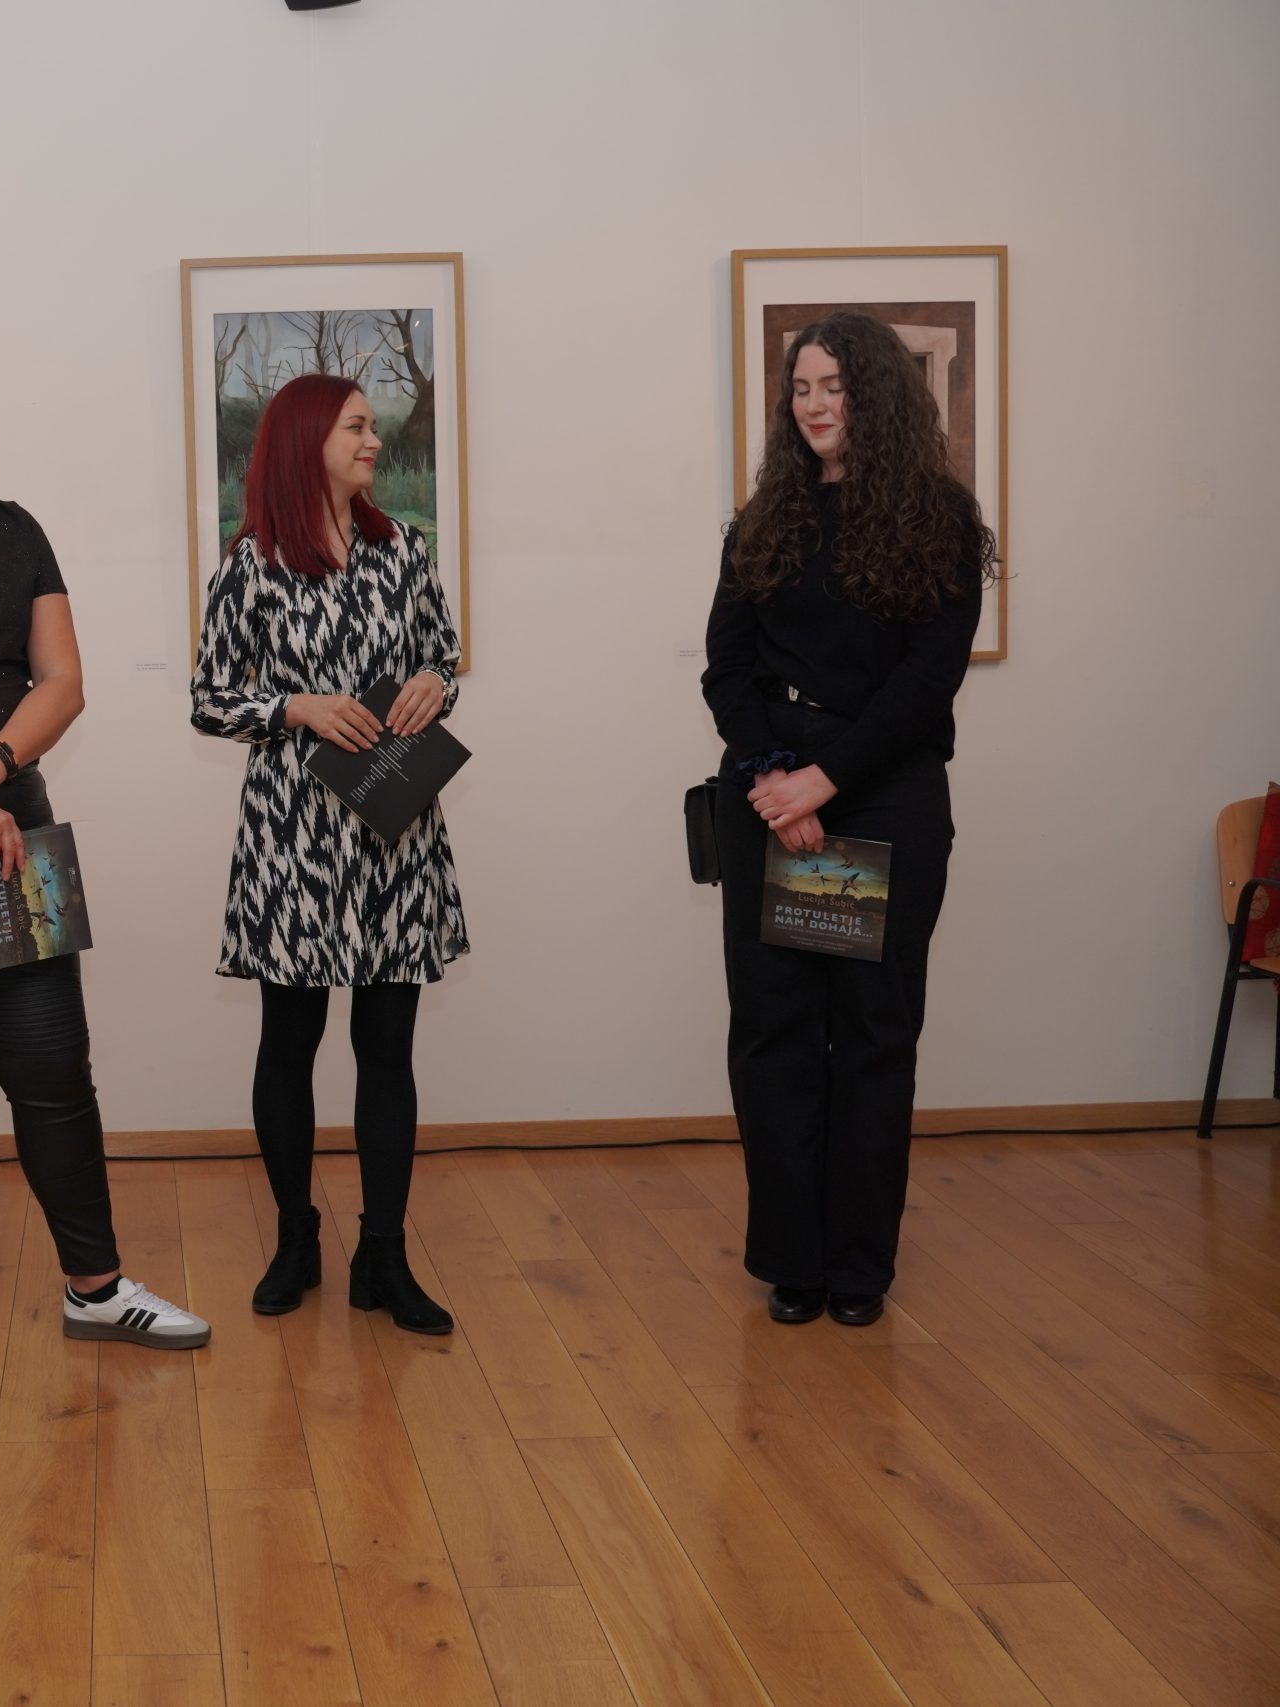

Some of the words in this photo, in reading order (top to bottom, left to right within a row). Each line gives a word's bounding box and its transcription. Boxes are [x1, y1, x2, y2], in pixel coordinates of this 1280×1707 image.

[798, 893, 826, 906] Lucija
[775, 905, 863, 926] PROTULETJE
[775, 915, 804, 927] NAM
[809, 919, 873, 938] DOHAJA...
